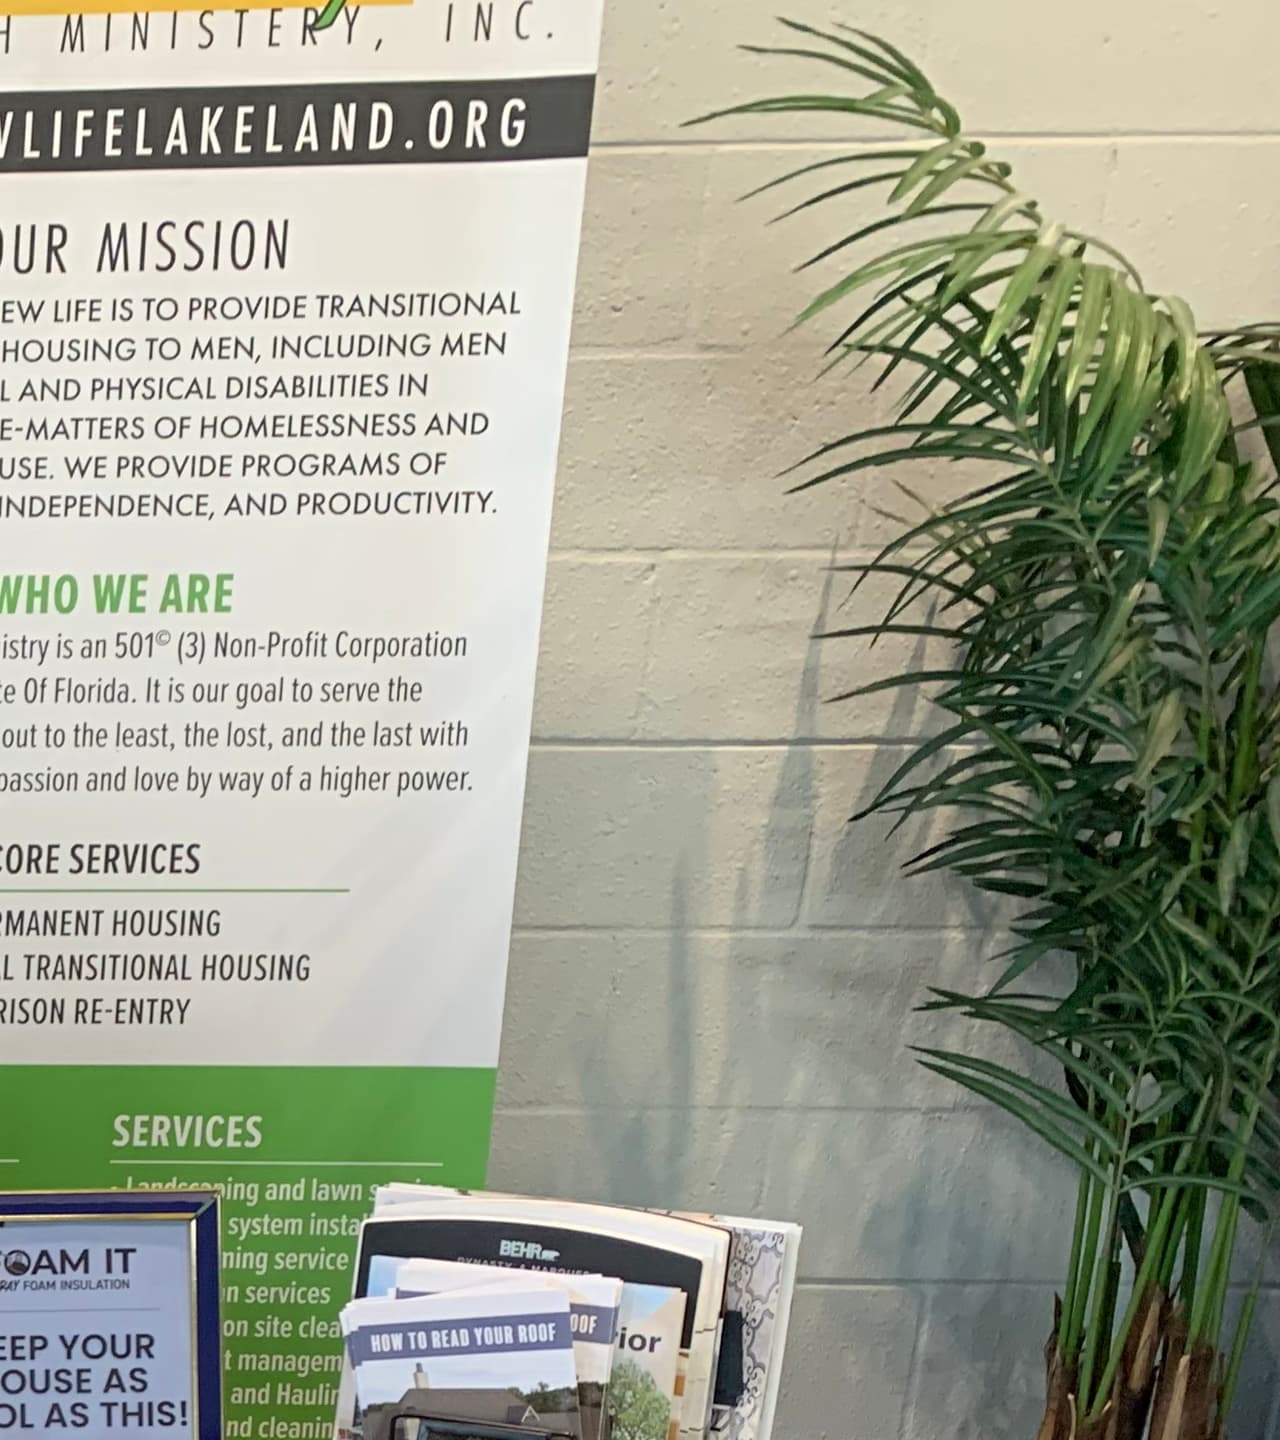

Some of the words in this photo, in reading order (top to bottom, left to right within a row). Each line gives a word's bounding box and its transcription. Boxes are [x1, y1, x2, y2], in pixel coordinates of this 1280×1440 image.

[446, 0, 552, 42] INC.
[97, 219, 288, 273] MISSION
[53, 299, 102, 323] LIFE
[112, 298, 133, 322] IS
[142, 298, 179, 321] TO
[189, 295, 307, 321] PROVIDE
[316, 291, 520, 318] TRANSITIONAL
[224, 493, 287, 516] AND
[297, 491, 497, 515] PRODUCTIVITY.
[93, 574, 148, 614] WE
[159, 573, 234, 613] ARE
[69, 843, 200, 874] SERVICES
[112, 910, 220, 937] HOUSING
[23, 954, 192, 981] TRANSITIONAL
[201, 954, 310, 981] HOUSING
[74, 998, 191, 1024] RE-ENTRY
[112, 1115, 262, 1148] SERVICES
[265, 1178, 305, 1201] and
[311, 1178, 362, 1201] lawn
[228, 1214, 303, 1240] system
[106, 1248, 136, 1274] IT
[274, 1246, 349, 1270] service
[499, 1239, 542, 1260] BEHR
[23, 1280, 56, 1291] FOAM
[60, 1278, 130, 1290] INSULATION
[245, 1281, 331, 1304] services
[254, 1315, 293, 1338] site
[298, 1315, 341, 1338] clea
[570, 1313, 598, 1335] OOF
[59, 1333, 154, 1360] YOUR
[371, 1333, 403, 1352] HOW
[407, 1331, 427, 1350] TO
[431, 1328, 469, 1348] READ
[473, 1325, 514, 1346] YOUR
[518, 1323, 556, 1343] ROOF
[103, 1367, 148, 1393] AS
[238, 1355, 340, 1380] managem
[231, 1382, 271, 1405] and
[276, 1383, 339, 1405] Haulin
[44, 1402, 89, 1428] AS
[99, 1400, 187, 1427] THIS!
[258, 1416, 334, 1438] cleanin
